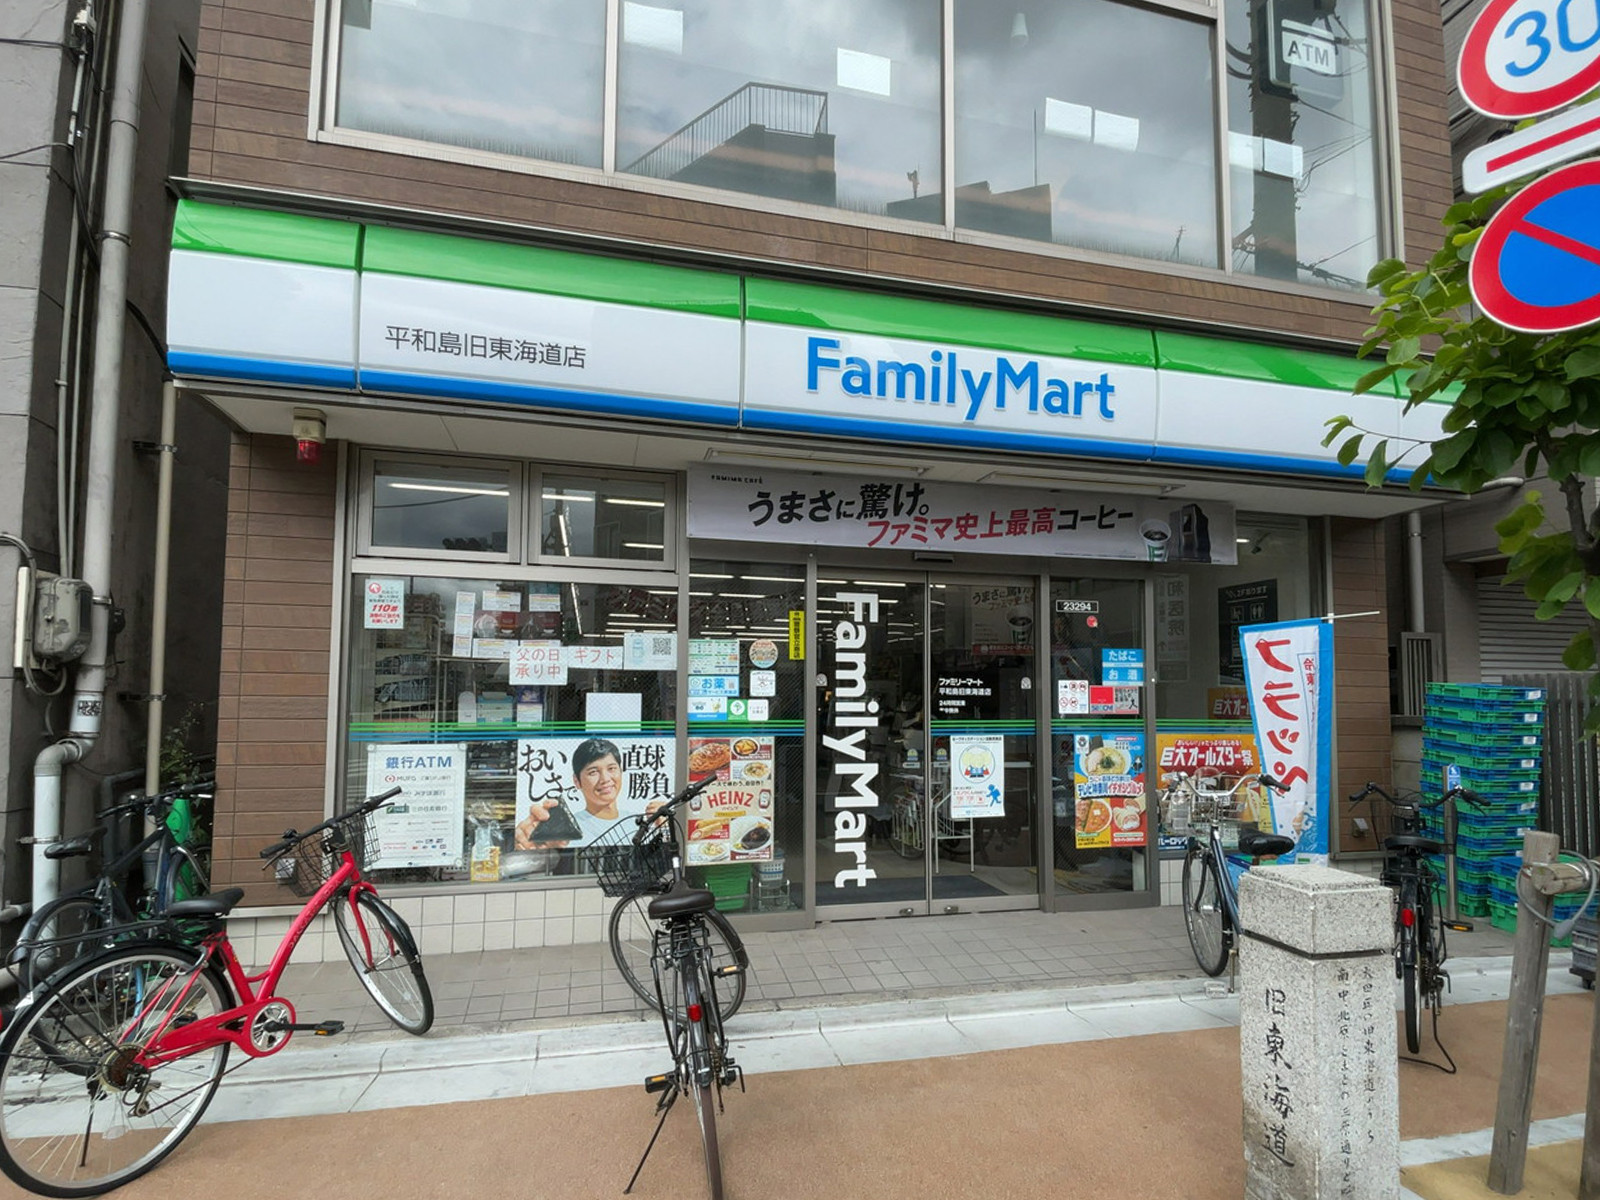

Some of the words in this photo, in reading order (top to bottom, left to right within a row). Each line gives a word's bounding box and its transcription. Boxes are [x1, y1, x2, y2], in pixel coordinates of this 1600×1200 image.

[1287, 38, 1330, 68] ATM
[1504, 0, 1600, 77] 30
[384, 323, 588, 370] 平和島旧東海道店
[806, 335, 1116, 424] FamilyMart
[747, 482, 930, 527] うまさに驚け。
[866, 504, 1134, 548] ファミマ史上最高コーヒー
[1062, 602, 1092, 612] 23294
[515, 647, 561, 662] 父の日
[1108, 650, 1137, 661] たばこ
[515, 663, 561, 678] 承り中
[822, 591, 879, 889] FamilyMart
[386, 755, 452, 769] 銀行ATM
[621, 743, 666, 773] 直球
[1159, 746, 1254, 767] 巨大オールスター祭
[706, 790, 754, 809] HEINZ
[1263, 987, 1296, 1169] 旧東海道
